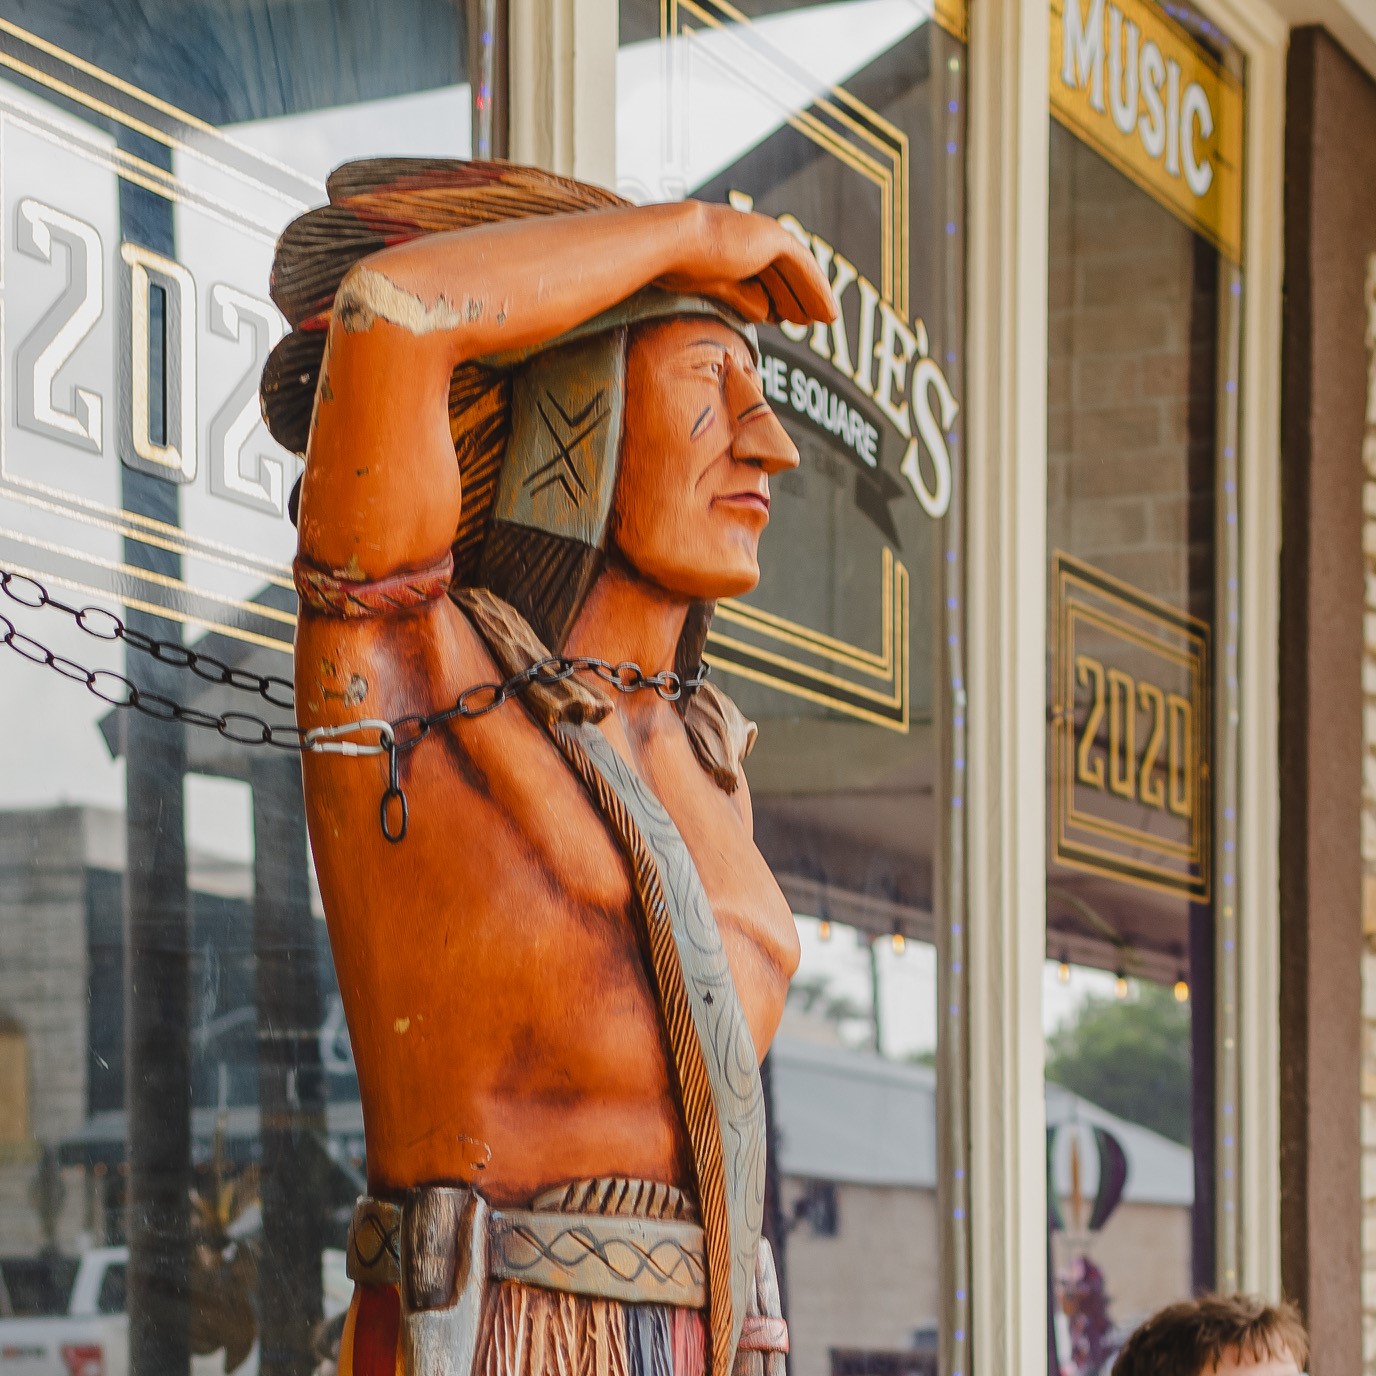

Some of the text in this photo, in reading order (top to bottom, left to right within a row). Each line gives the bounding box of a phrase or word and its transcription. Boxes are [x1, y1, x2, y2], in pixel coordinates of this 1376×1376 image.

[1061, 0, 1214, 197] MUSIC
[754, 352, 879, 469] HE SQUARE
[1075, 654, 1193, 820] 2020
